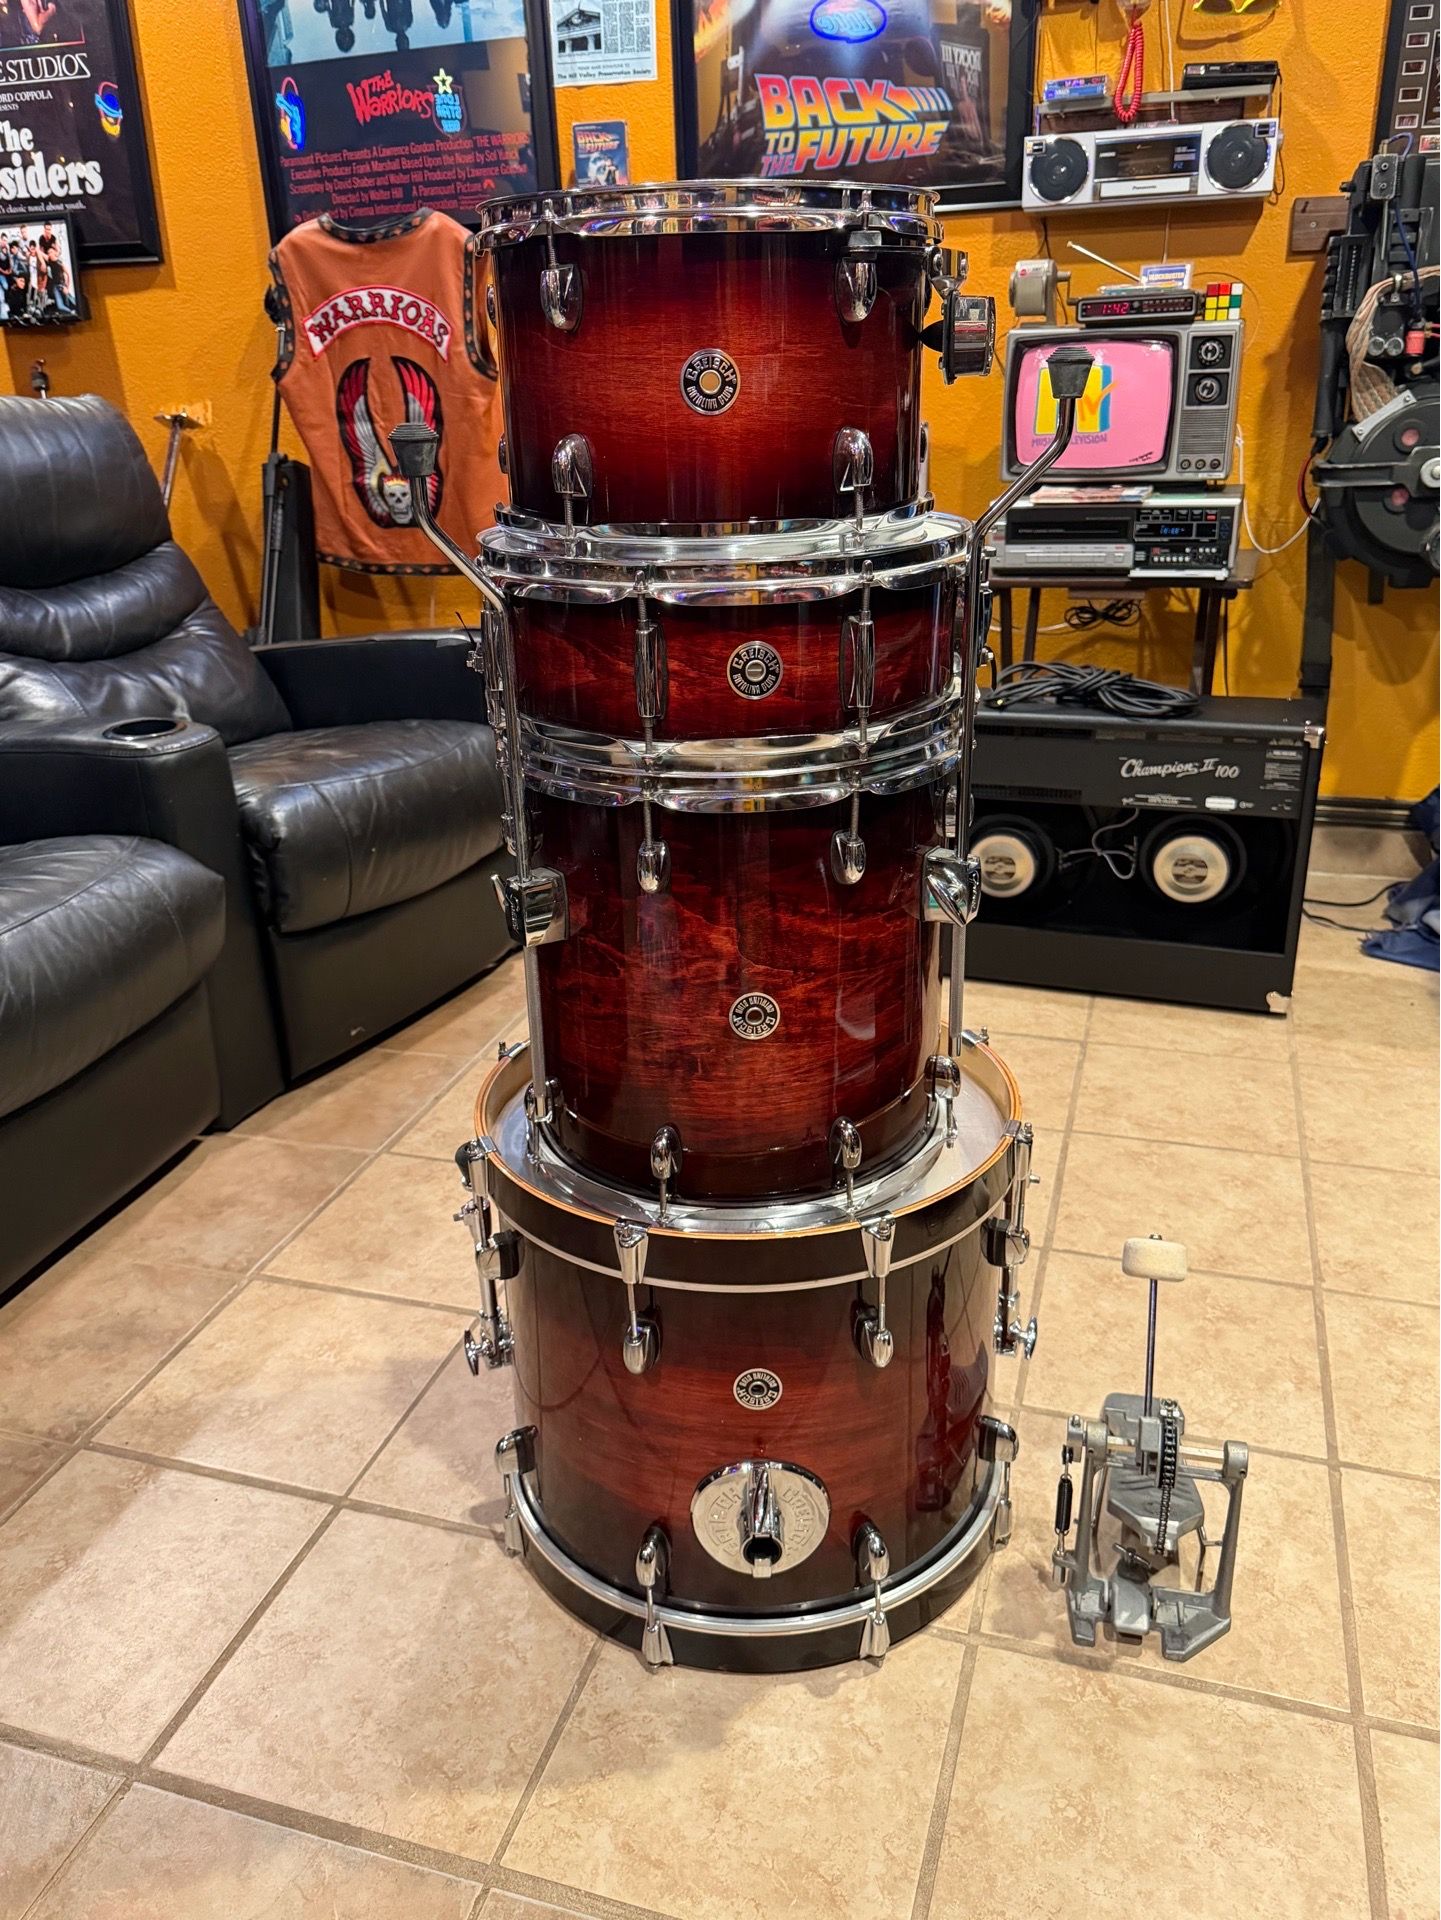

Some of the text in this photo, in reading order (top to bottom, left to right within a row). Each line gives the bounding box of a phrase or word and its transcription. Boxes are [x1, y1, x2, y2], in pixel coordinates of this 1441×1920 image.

[6, 53, 90, 82] STUDIOS
[15, 90, 53, 102] COPPOLA
[754, 73, 948, 130] BACK
[436, 138, 473, 151] Production
[764, 130, 796, 155] TO
[793, 121, 950, 173] FUTURE
[401, 156, 423, 169] Based
[760, 154, 796, 177] THE
[307, 291, 449, 347] WARRIORS
[1102, 302, 1130, 315] 1:42
[685, 354, 736, 381] GRETSCH
[1069, 433, 1107, 445] LEVISION
[732, 646, 778, 670] GRETSCH
[1120, 758, 1199, 778] Champion
[1214, 765, 1240, 778] 100
[733, 1016, 776, 1035] GRETSCH
[737, 1389, 778, 1406] GRETSCH
